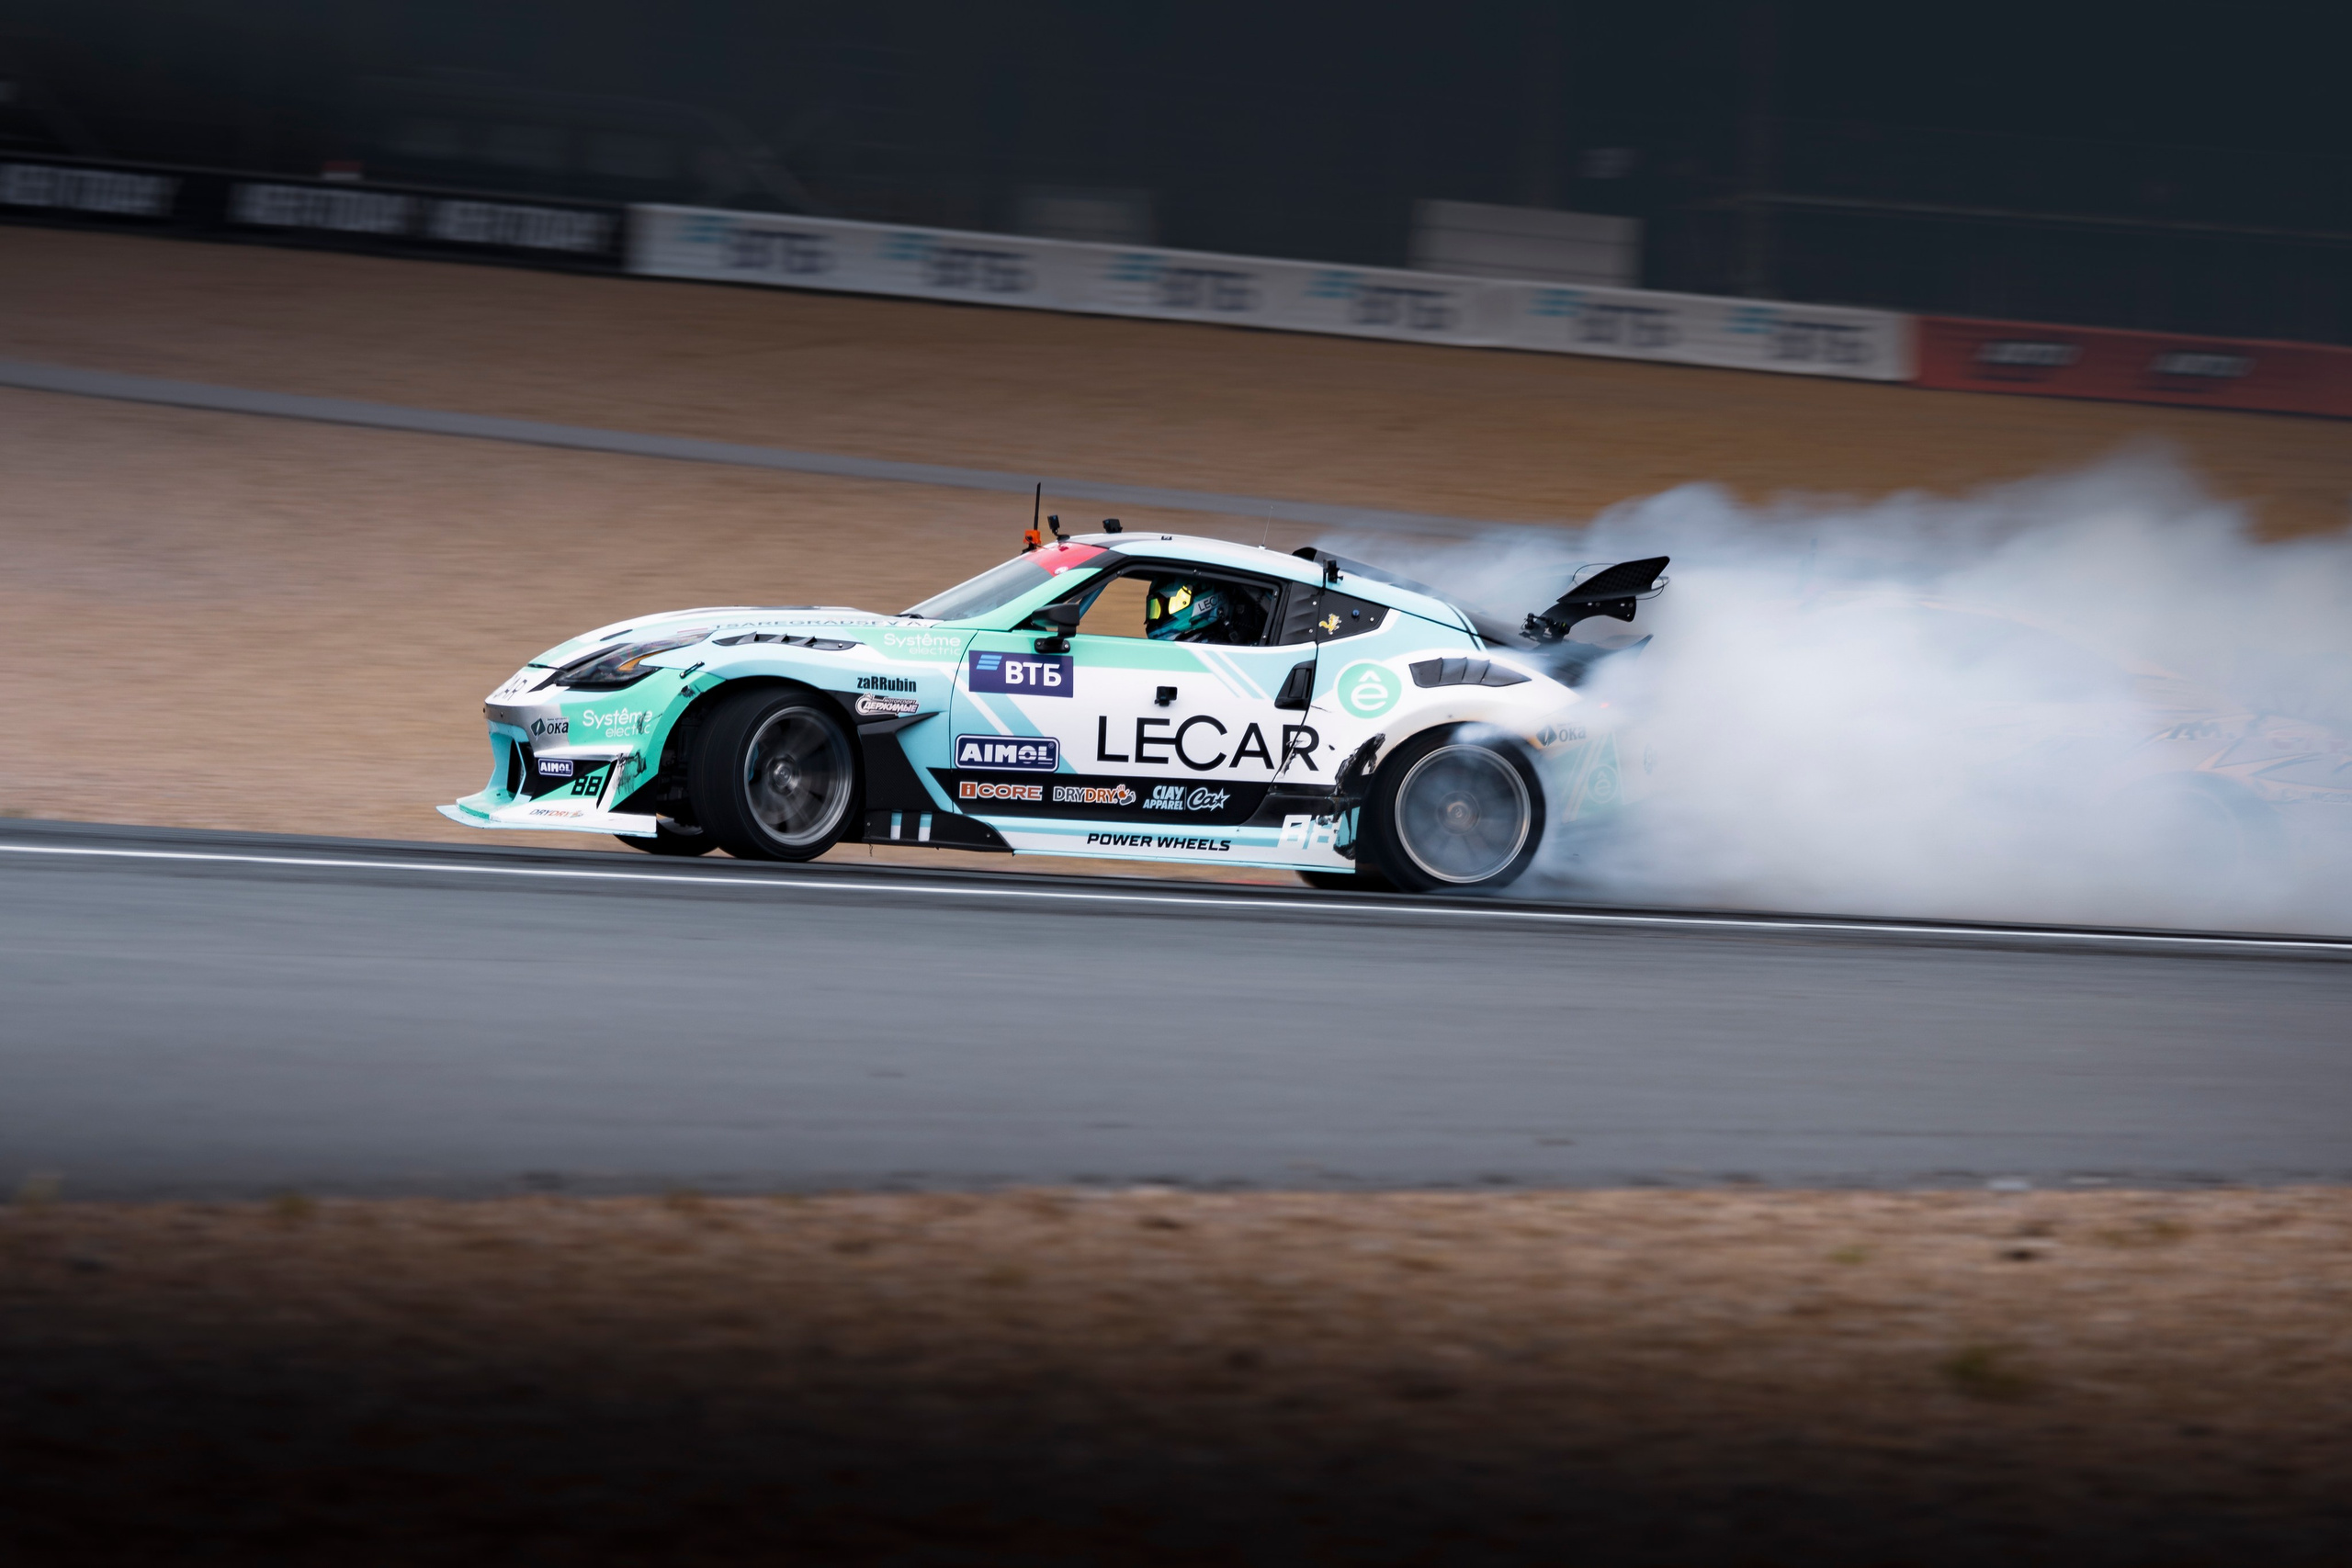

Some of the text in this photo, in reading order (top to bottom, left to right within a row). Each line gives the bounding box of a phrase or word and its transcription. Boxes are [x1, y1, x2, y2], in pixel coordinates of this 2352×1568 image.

[883, 633, 961, 648] Système
[909, 646, 962, 656] electric
[1004, 660, 1062, 687] ВТБ
[856, 676, 917, 693] zaRRubin
[582, 707, 653, 729] Système
[605, 724, 650, 739] electric
[1096, 715, 1320, 772] LECAR
[959, 742, 1054, 765] AIMOL
[539, 761, 572, 773] AIMOL
[570, 775, 604, 796] 88
[1142, 799, 1183, 810] APPAREL
[1277, 814, 1342, 851] 88
[1087, 833, 1232, 852] POWER WHEELS
